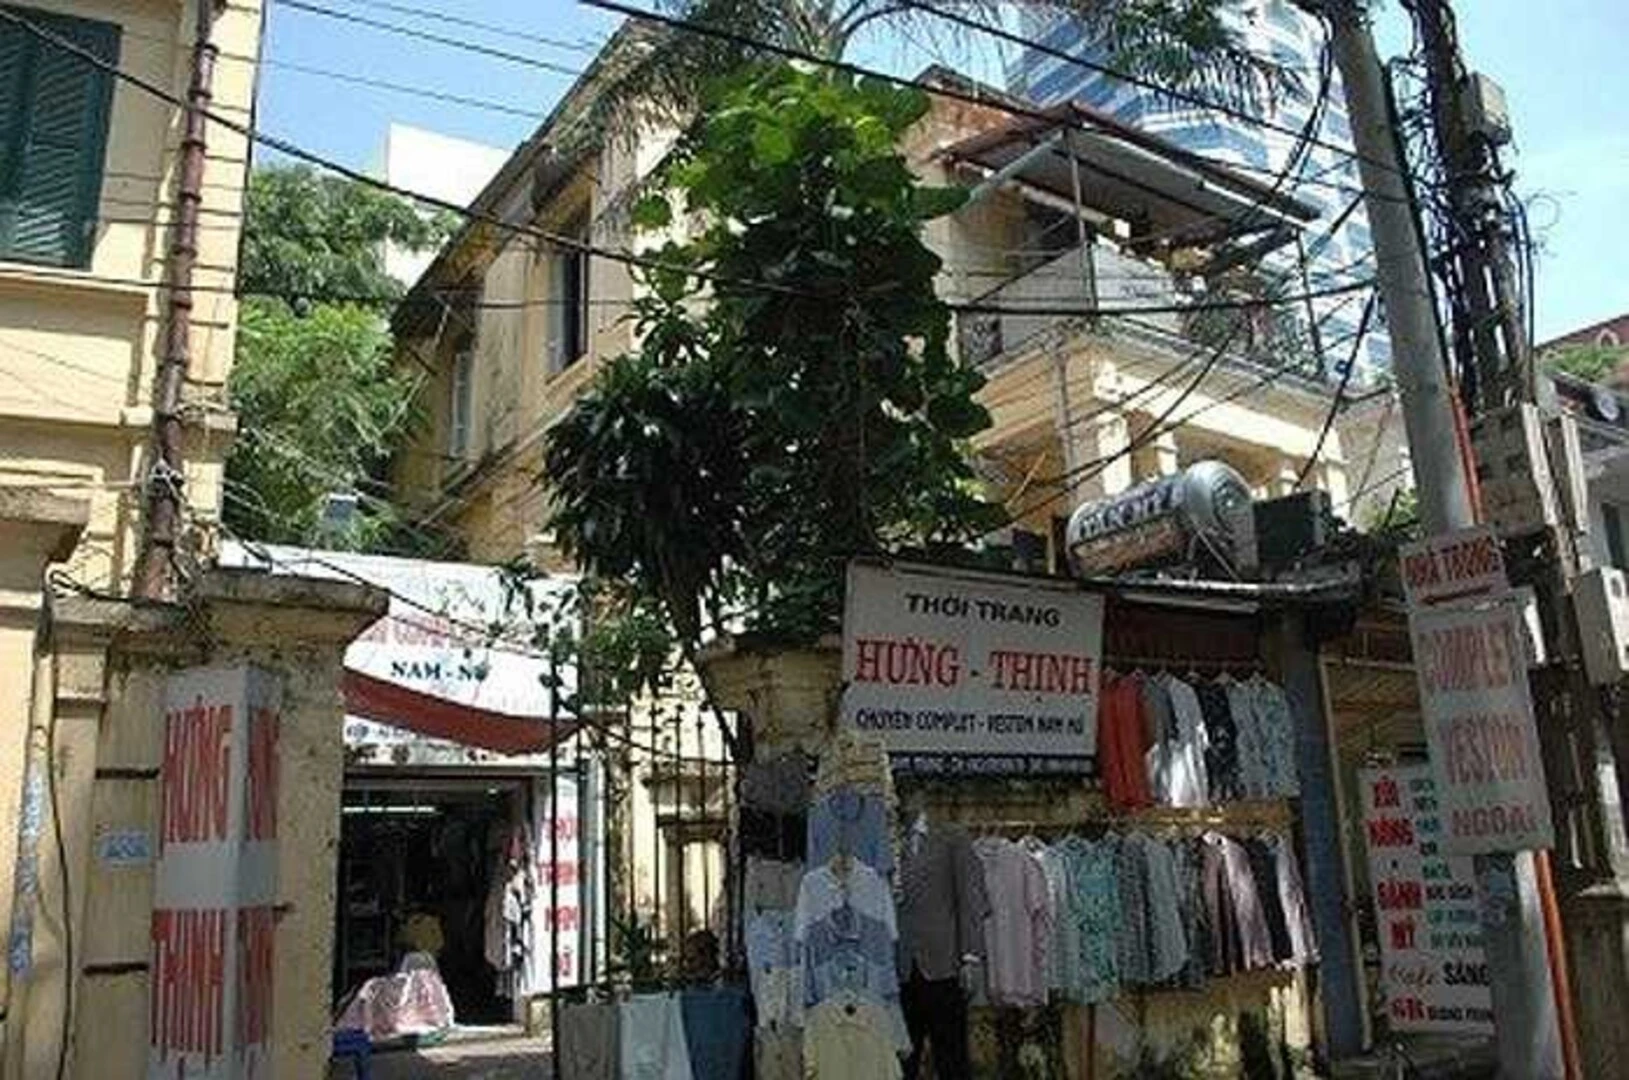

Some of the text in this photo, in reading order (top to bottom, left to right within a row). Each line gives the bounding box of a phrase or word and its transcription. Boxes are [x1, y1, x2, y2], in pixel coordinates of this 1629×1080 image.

[907, 592, 1061, 628] THỜI TRANG
[391, 661, 441, 681] NAM
[987, 650, 1094, 703] THỊNH
